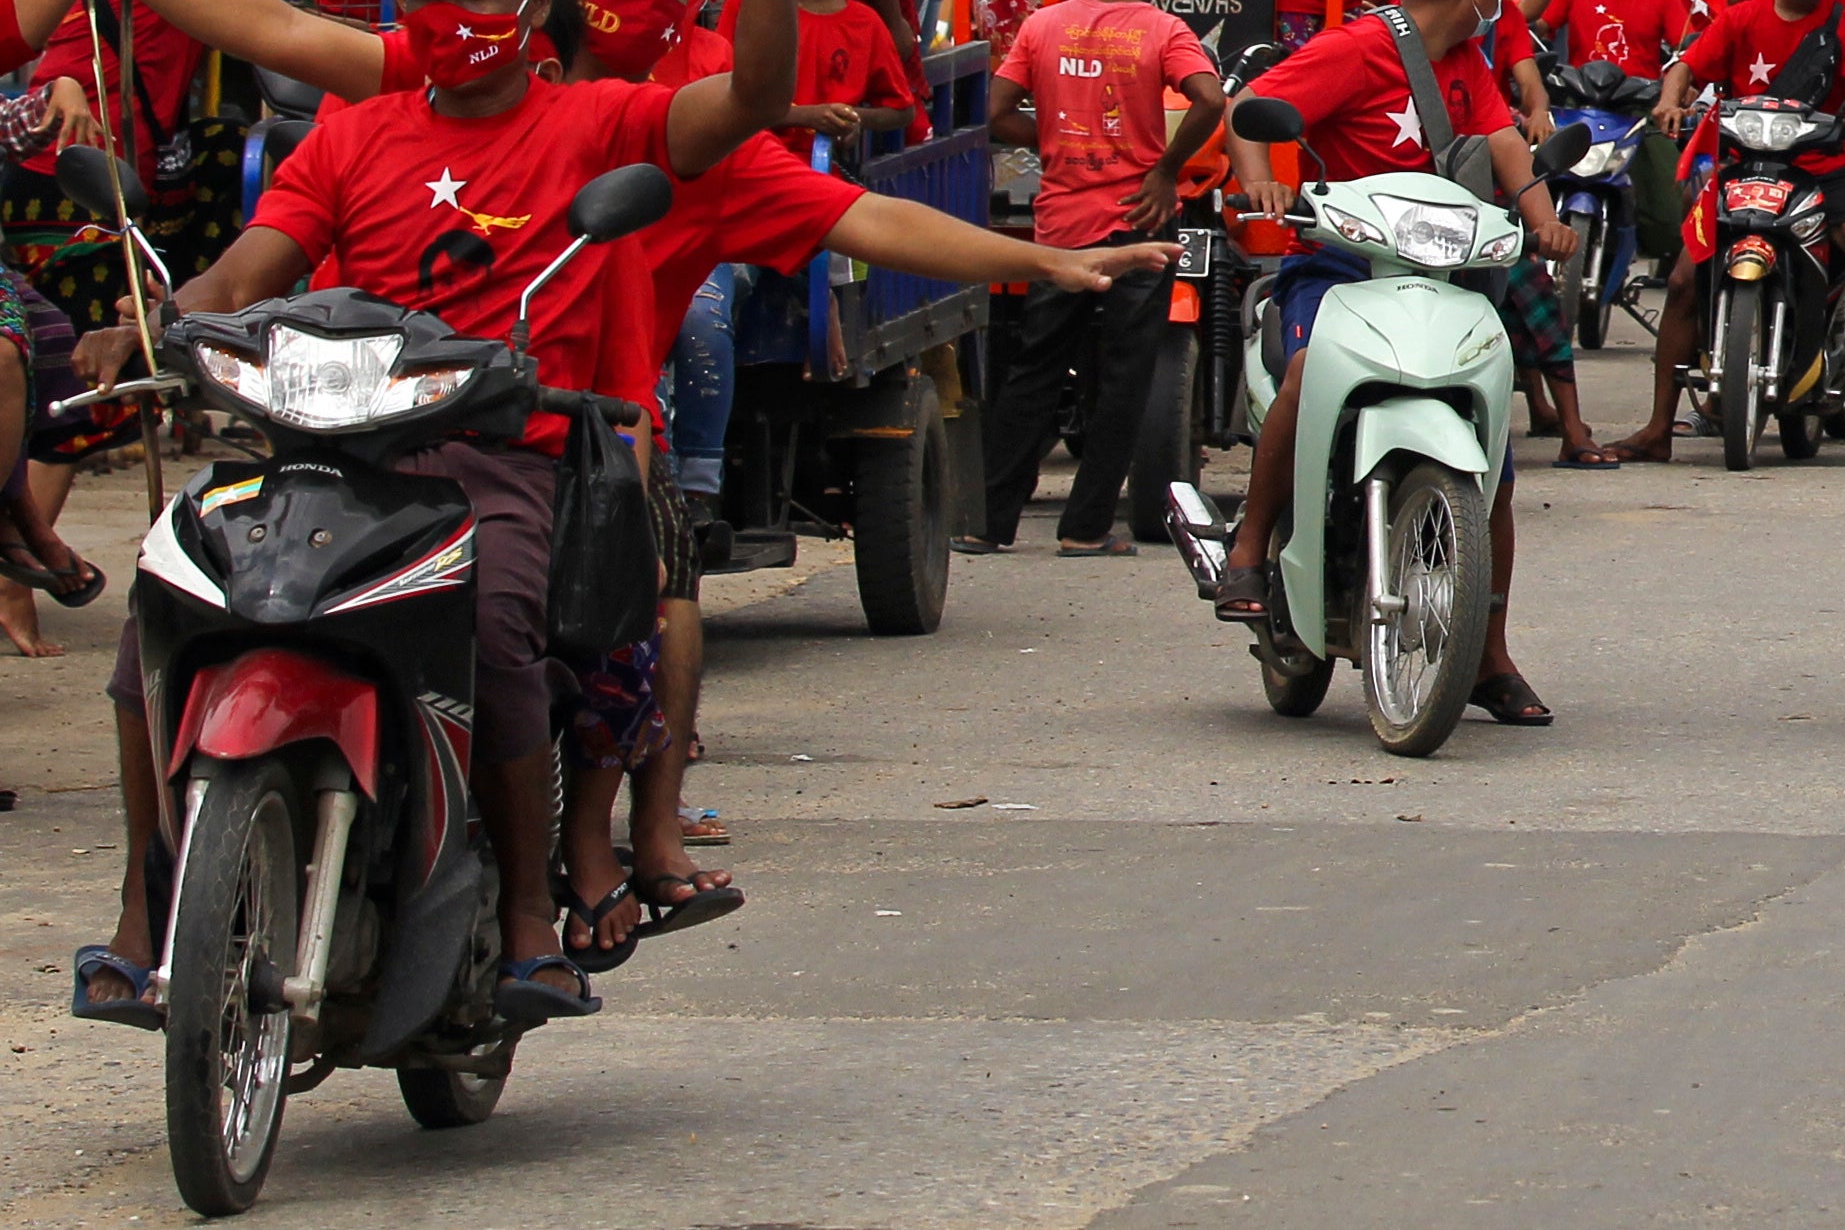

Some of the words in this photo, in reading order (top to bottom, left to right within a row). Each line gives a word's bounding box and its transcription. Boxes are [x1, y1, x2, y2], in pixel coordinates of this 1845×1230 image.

[469, 44, 499, 64] NLD
[1059, 57, 1103, 78] NLD
[1396, 282, 1439, 294] HONDA
[279, 463, 343, 478] HONDA
